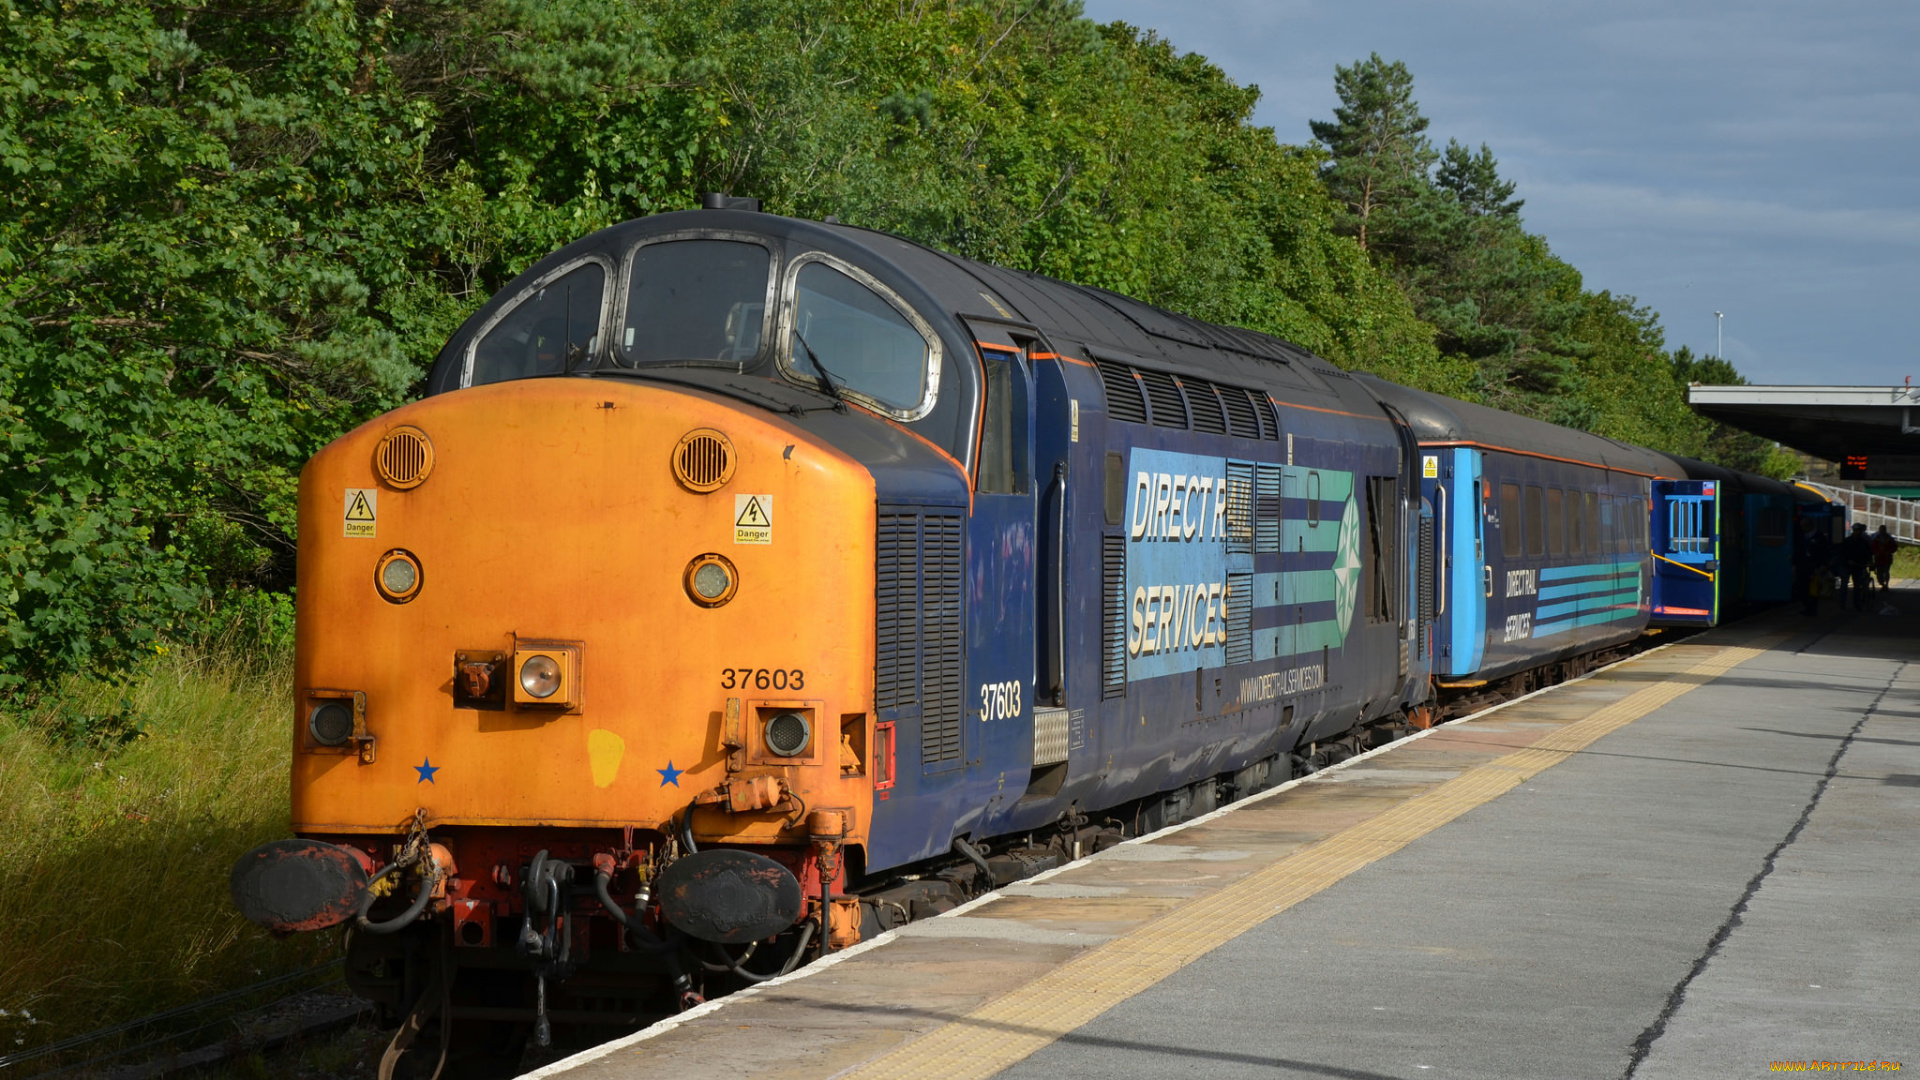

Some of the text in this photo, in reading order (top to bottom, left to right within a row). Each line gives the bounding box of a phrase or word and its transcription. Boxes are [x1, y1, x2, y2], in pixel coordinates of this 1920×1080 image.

[1131, 471, 1253, 543] DIRECT RAIL
[346, 523, 374, 533] Danger
[737, 529, 769, 540] Danger
[1128, 582, 1232, 660] SERVICES
[1503, 612, 1531, 644] SERVICES
[721, 668, 805, 691] 37603
[980, 680, 1021, 722] 37603
